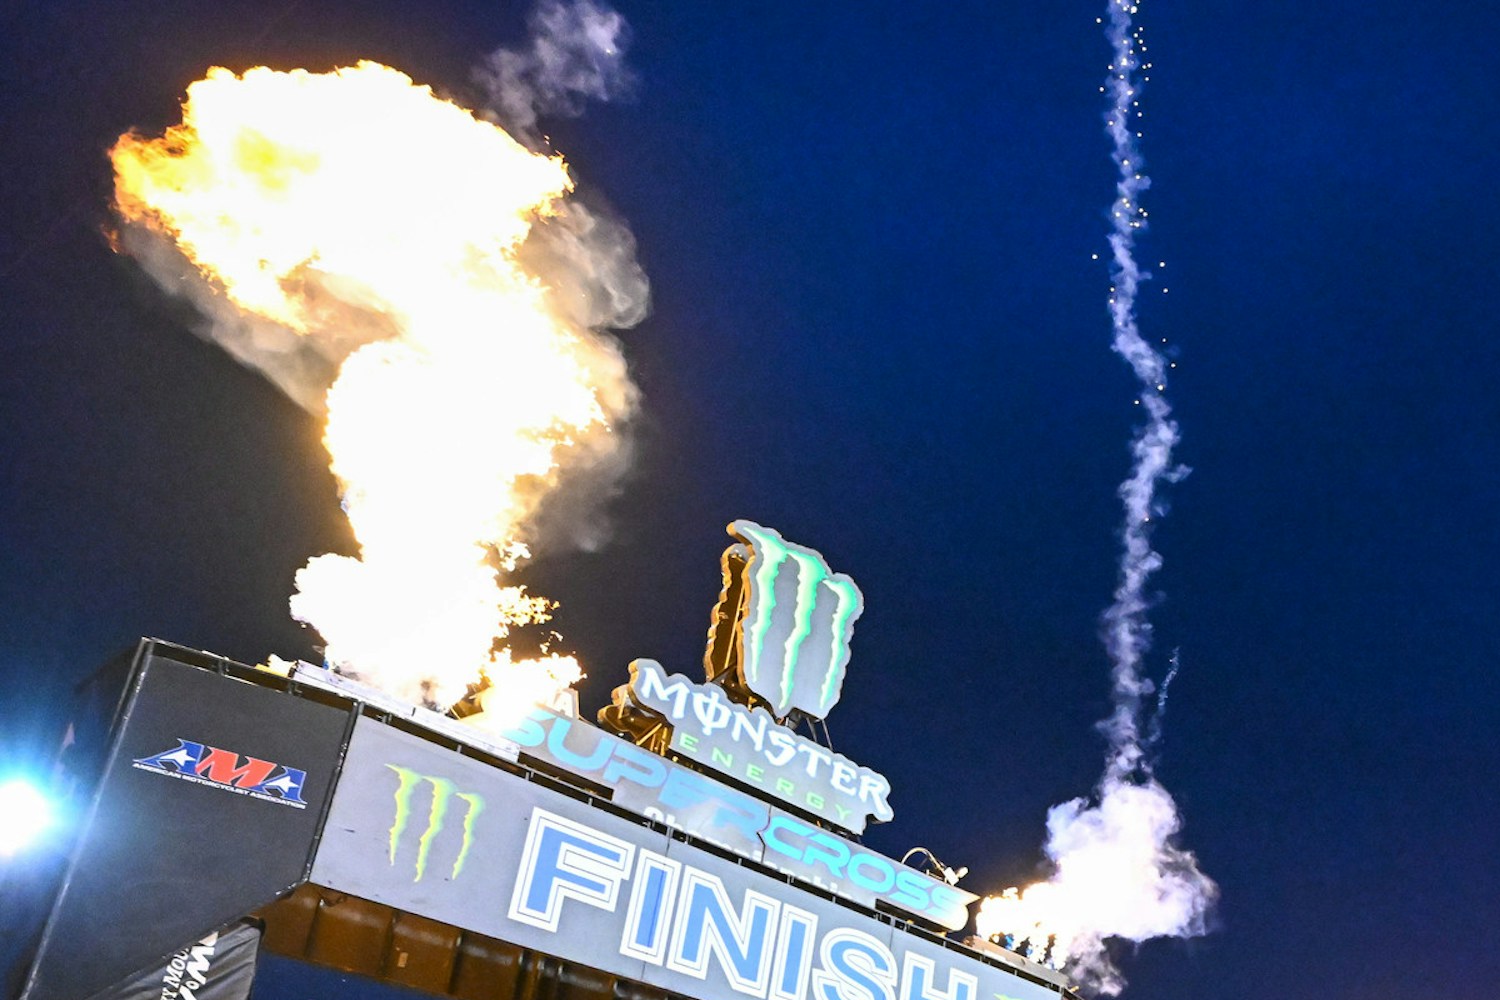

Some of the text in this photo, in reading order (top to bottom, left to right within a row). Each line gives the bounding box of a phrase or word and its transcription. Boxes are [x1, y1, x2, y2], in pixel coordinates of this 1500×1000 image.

[132, 738, 307, 805] AMA
[132, 763, 307, 810] AMERICAN MOTORCYCLIST ASSOCIATION
[679, 732, 853, 820] ENERGY
[500, 703, 967, 919] SUPERCROSS
